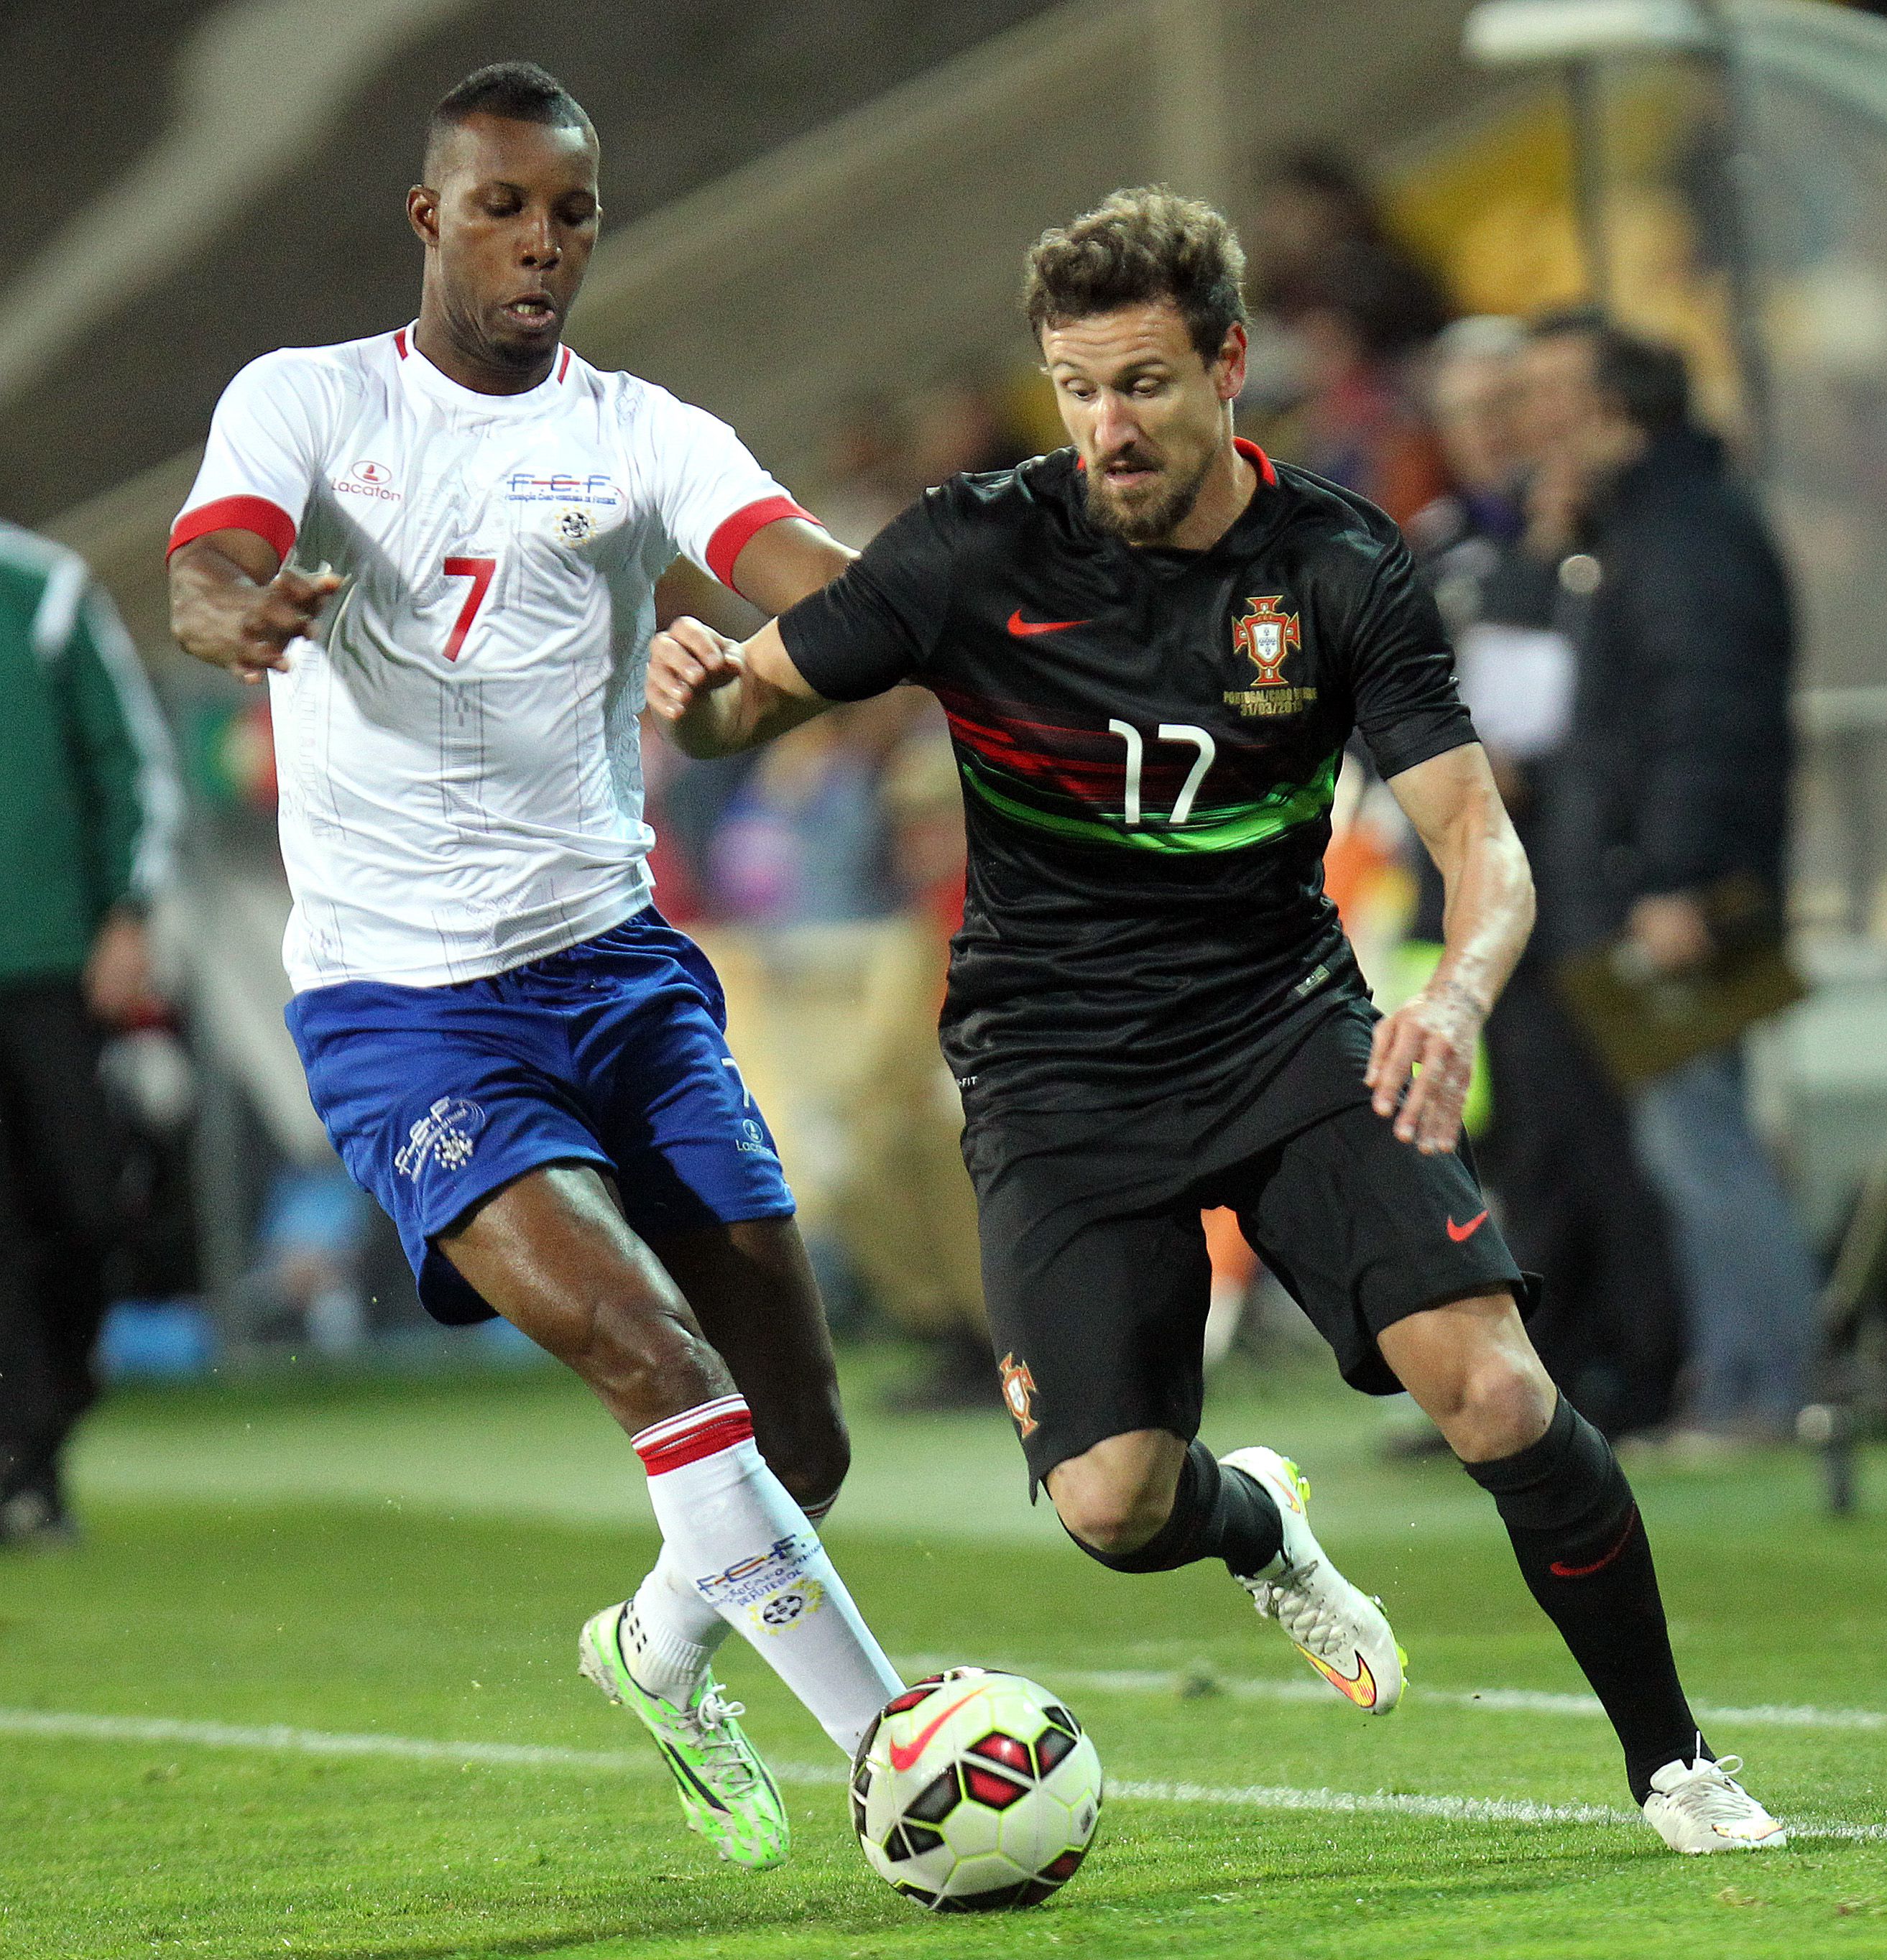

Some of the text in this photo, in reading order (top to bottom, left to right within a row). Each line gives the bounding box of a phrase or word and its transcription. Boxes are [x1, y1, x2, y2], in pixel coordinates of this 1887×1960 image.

[331, 477, 401, 501] Lacaton
[443, 557, 497, 662] 7
[1109, 718, 1215, 824] 17
